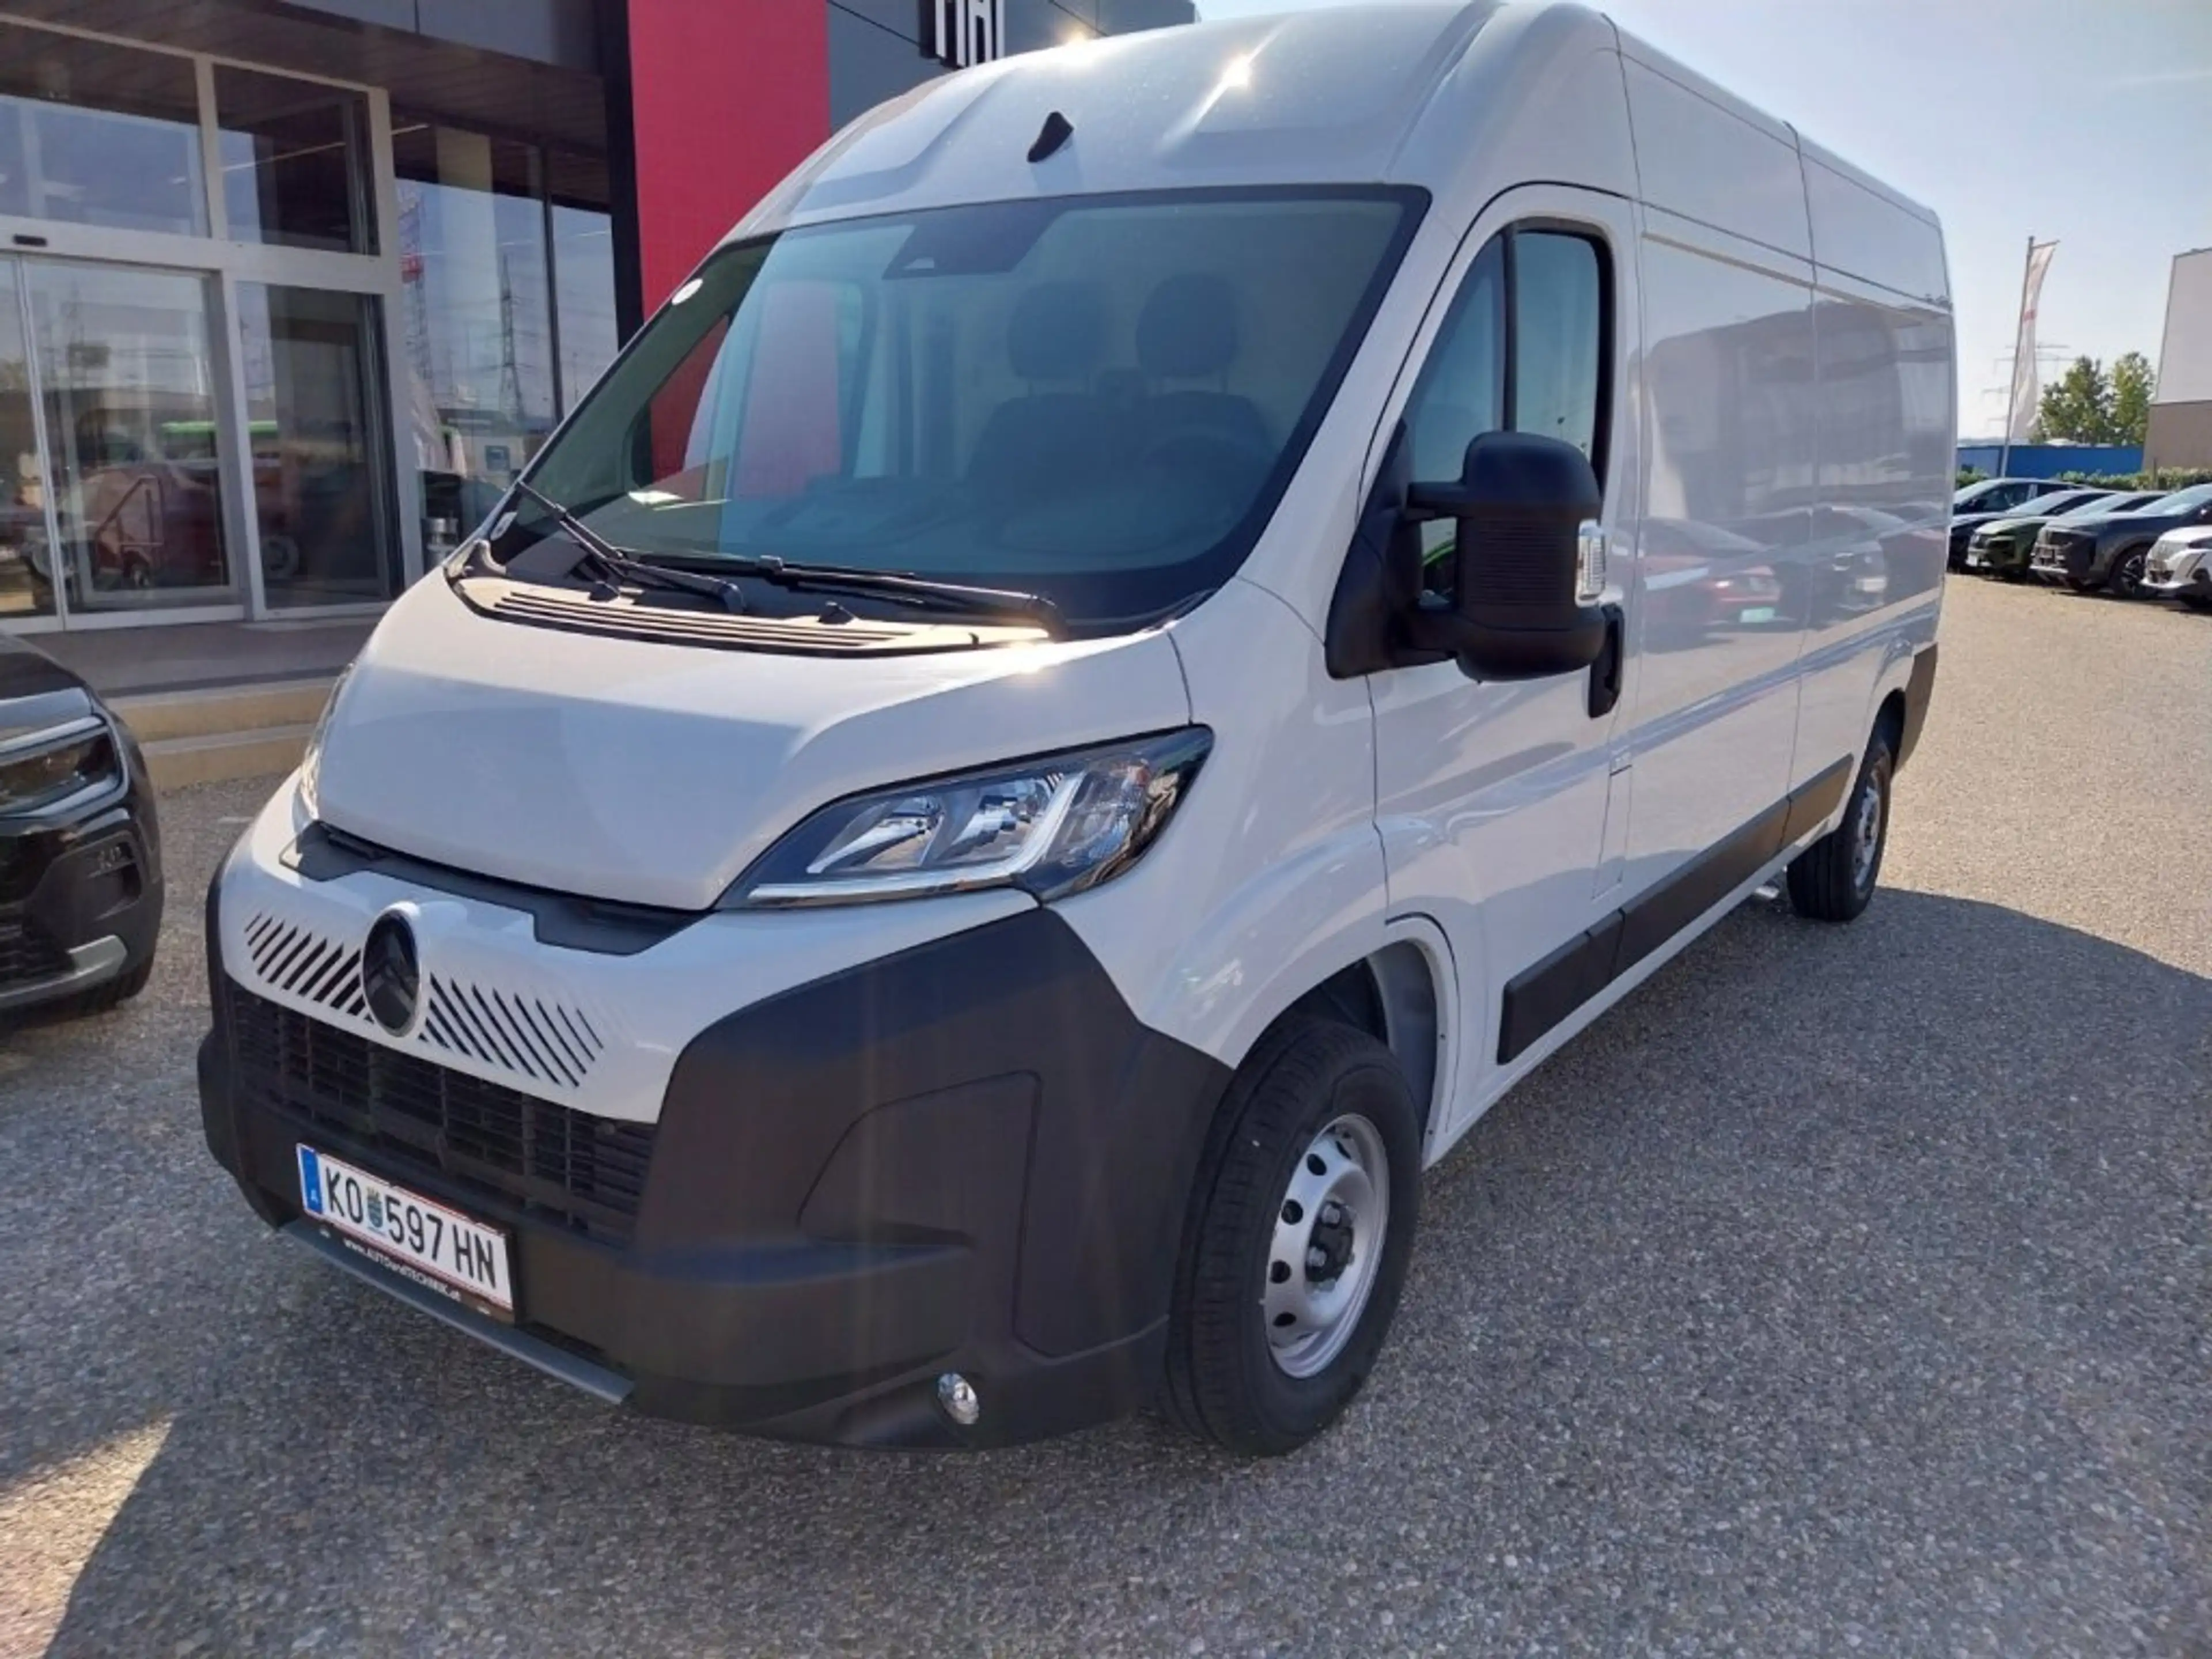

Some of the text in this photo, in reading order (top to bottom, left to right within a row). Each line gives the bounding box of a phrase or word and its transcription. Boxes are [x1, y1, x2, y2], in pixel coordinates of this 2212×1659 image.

[326, 1166, 363, 1224] KO
[385, 1194, 443, 1262] 597
[453, 1224, 496, 1290] HN
